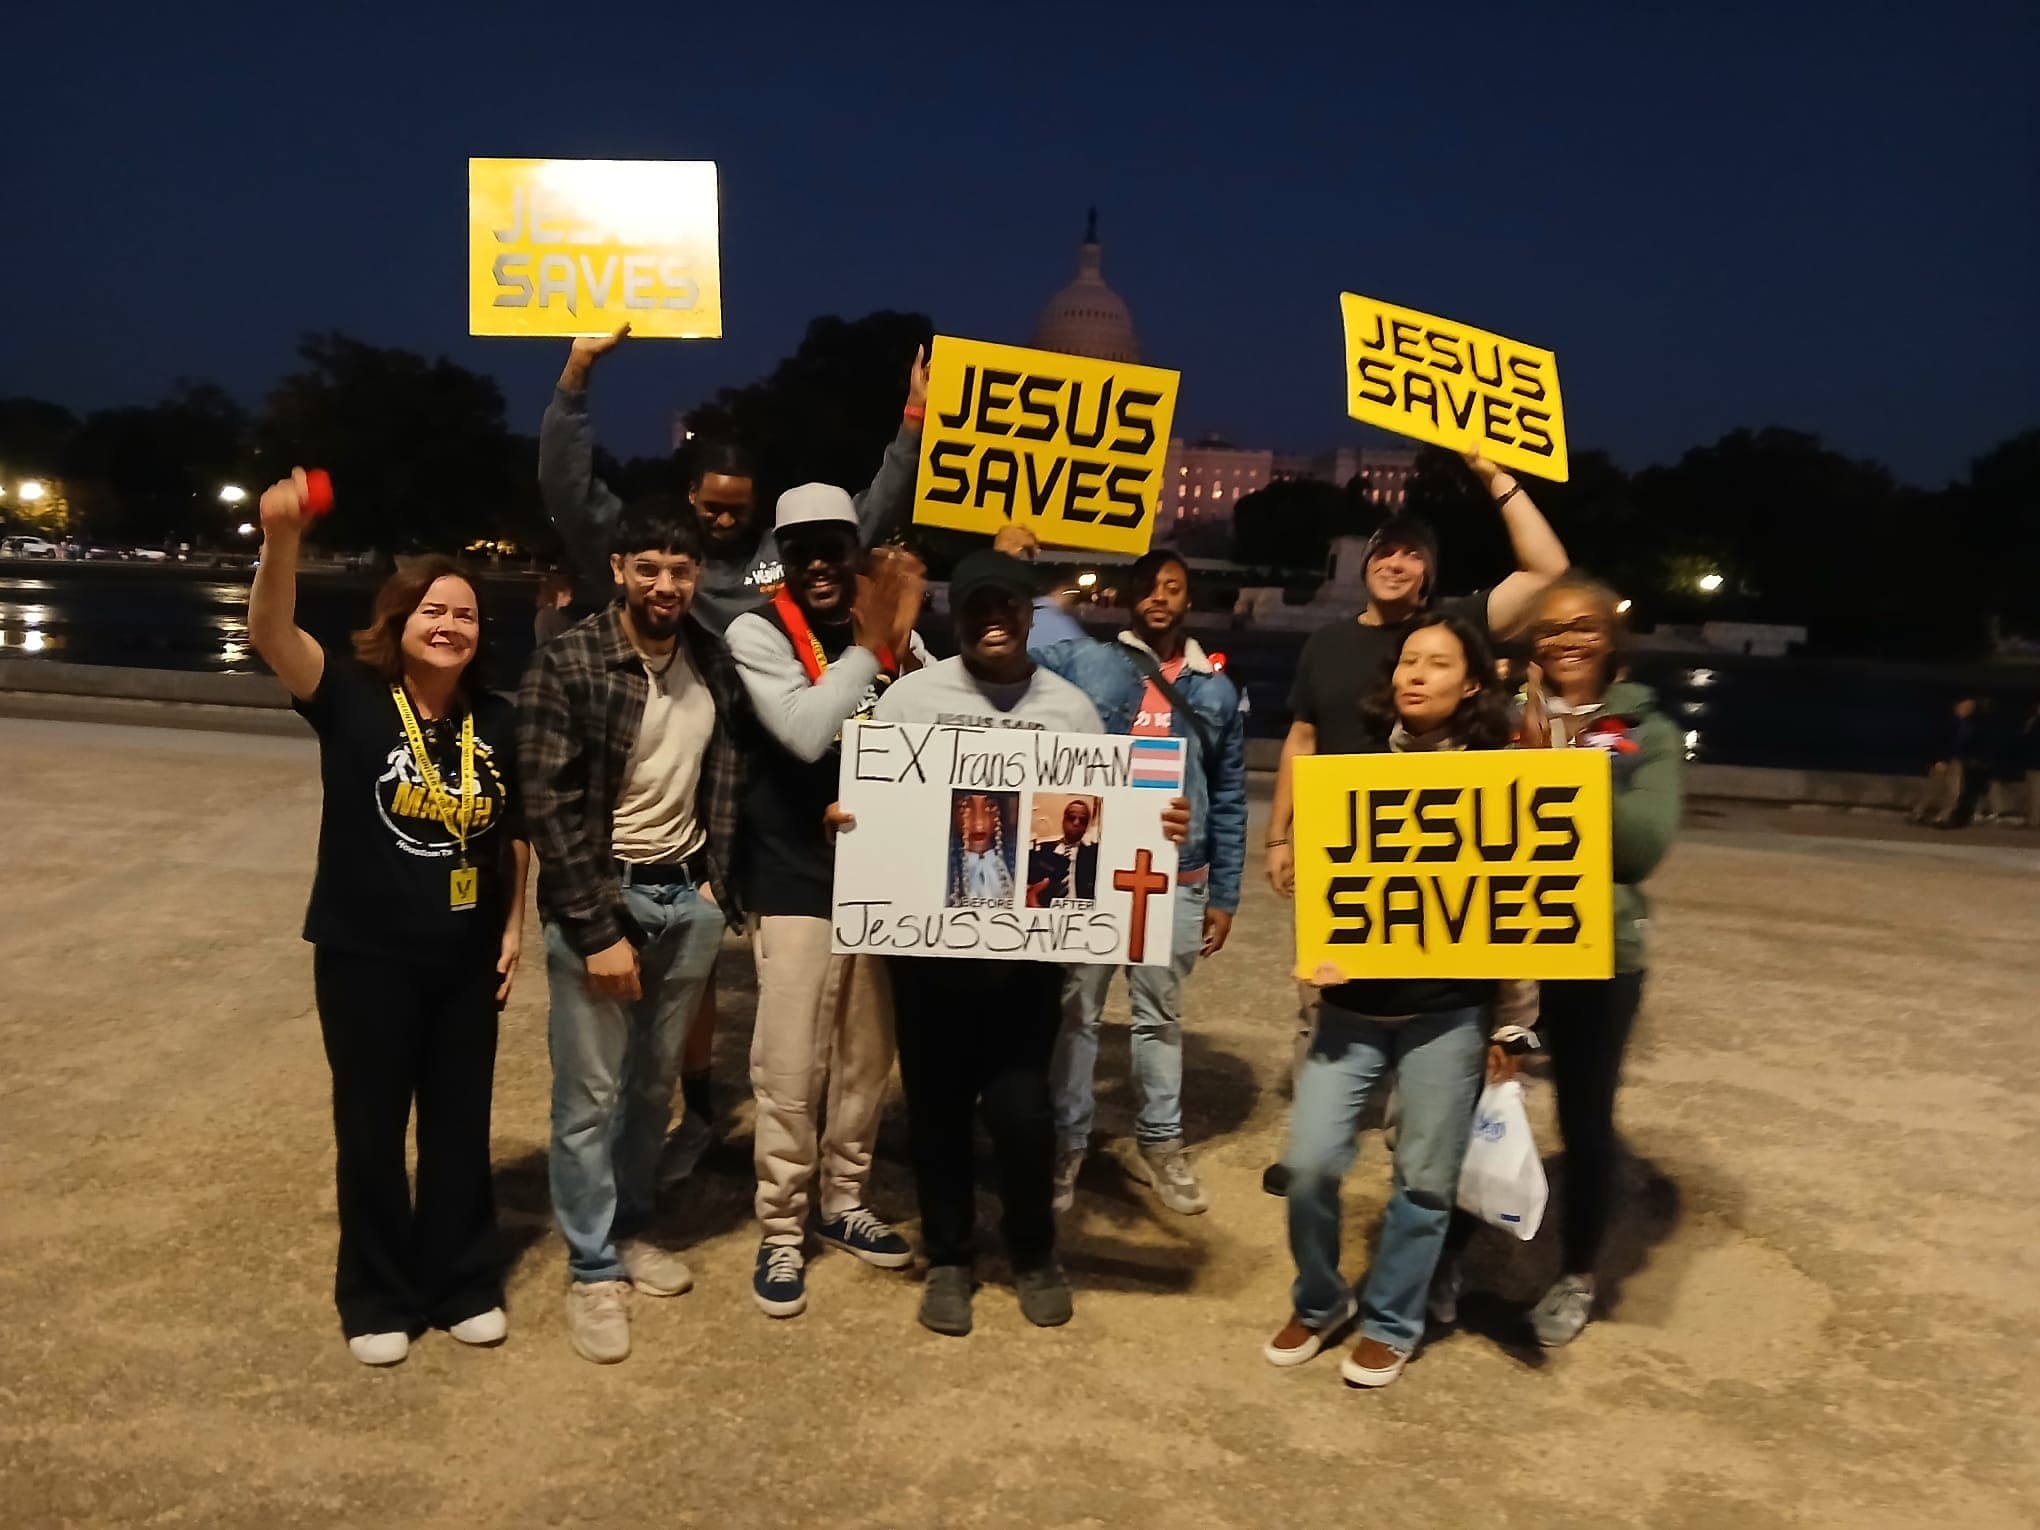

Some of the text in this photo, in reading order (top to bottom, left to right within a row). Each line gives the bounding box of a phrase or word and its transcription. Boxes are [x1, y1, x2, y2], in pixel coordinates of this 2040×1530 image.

[492, 253, 699, 317] SAVES
[1360, 314, 1545, 402] JESUS
[938, 365, 1164, 455] JESUS
[1358, 356, 1554, 457] SAVES
[925, 440, 1153, 529] SAVES
[855, 724, 935, 783] EX
[391, 782, 493, 829] MAH
[1325, 776, 1584, 863] JESUS
[1052, 899, 1094, 910] AFTER
[1325, 874, 1584, 955] SAVES
